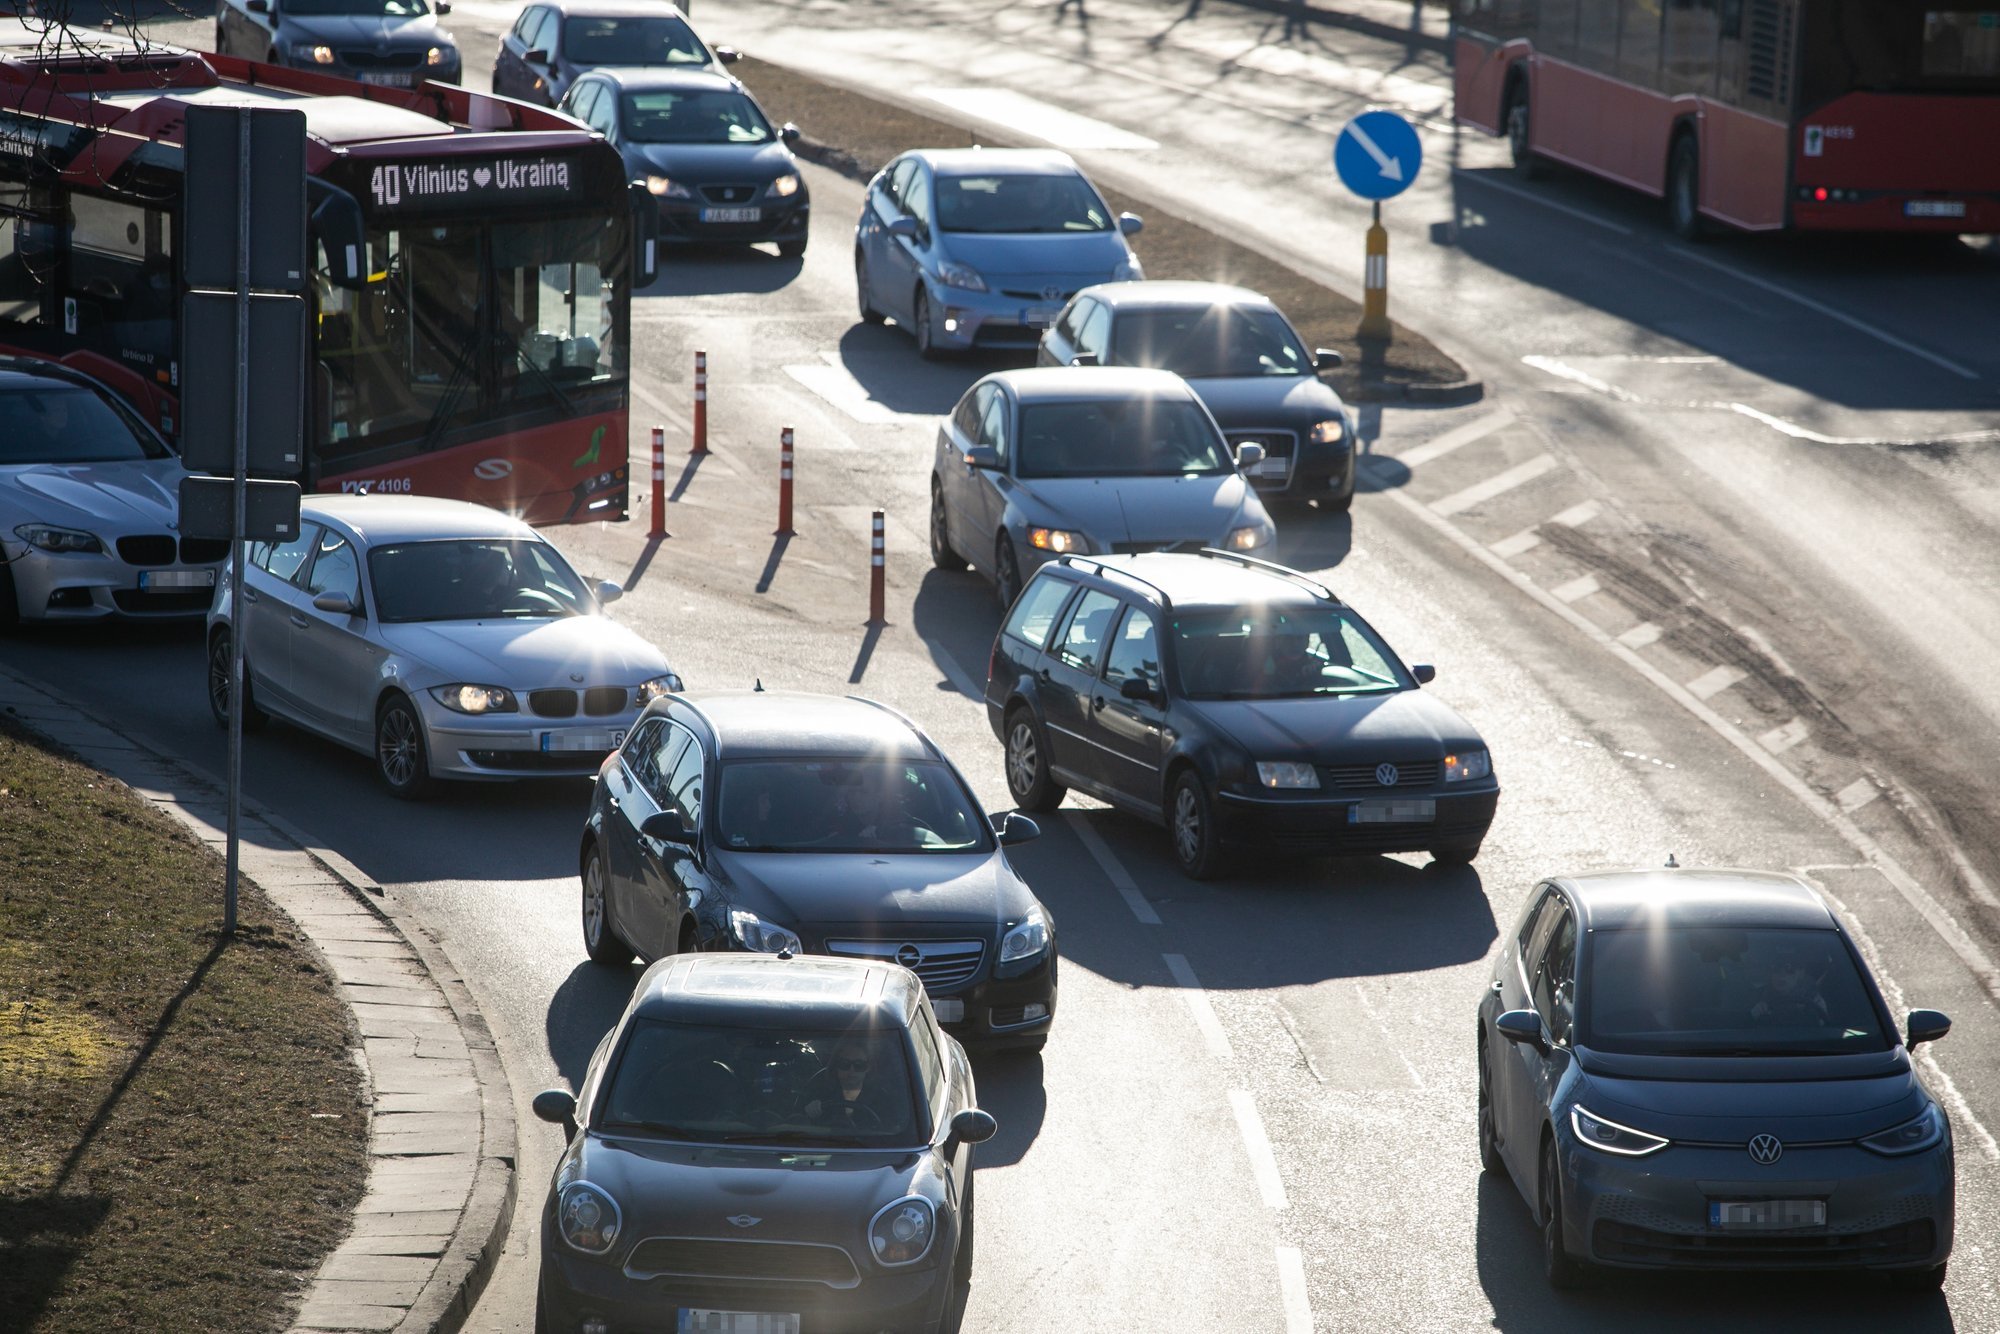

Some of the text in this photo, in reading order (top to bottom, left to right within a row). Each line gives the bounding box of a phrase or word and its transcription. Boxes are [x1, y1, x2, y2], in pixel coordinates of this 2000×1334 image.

[371, 157, 570, 205] 40 Vilnius Ukrainą
[122, 348, 146, 362] Urbino
[378, 477, 411, 493] 4106
